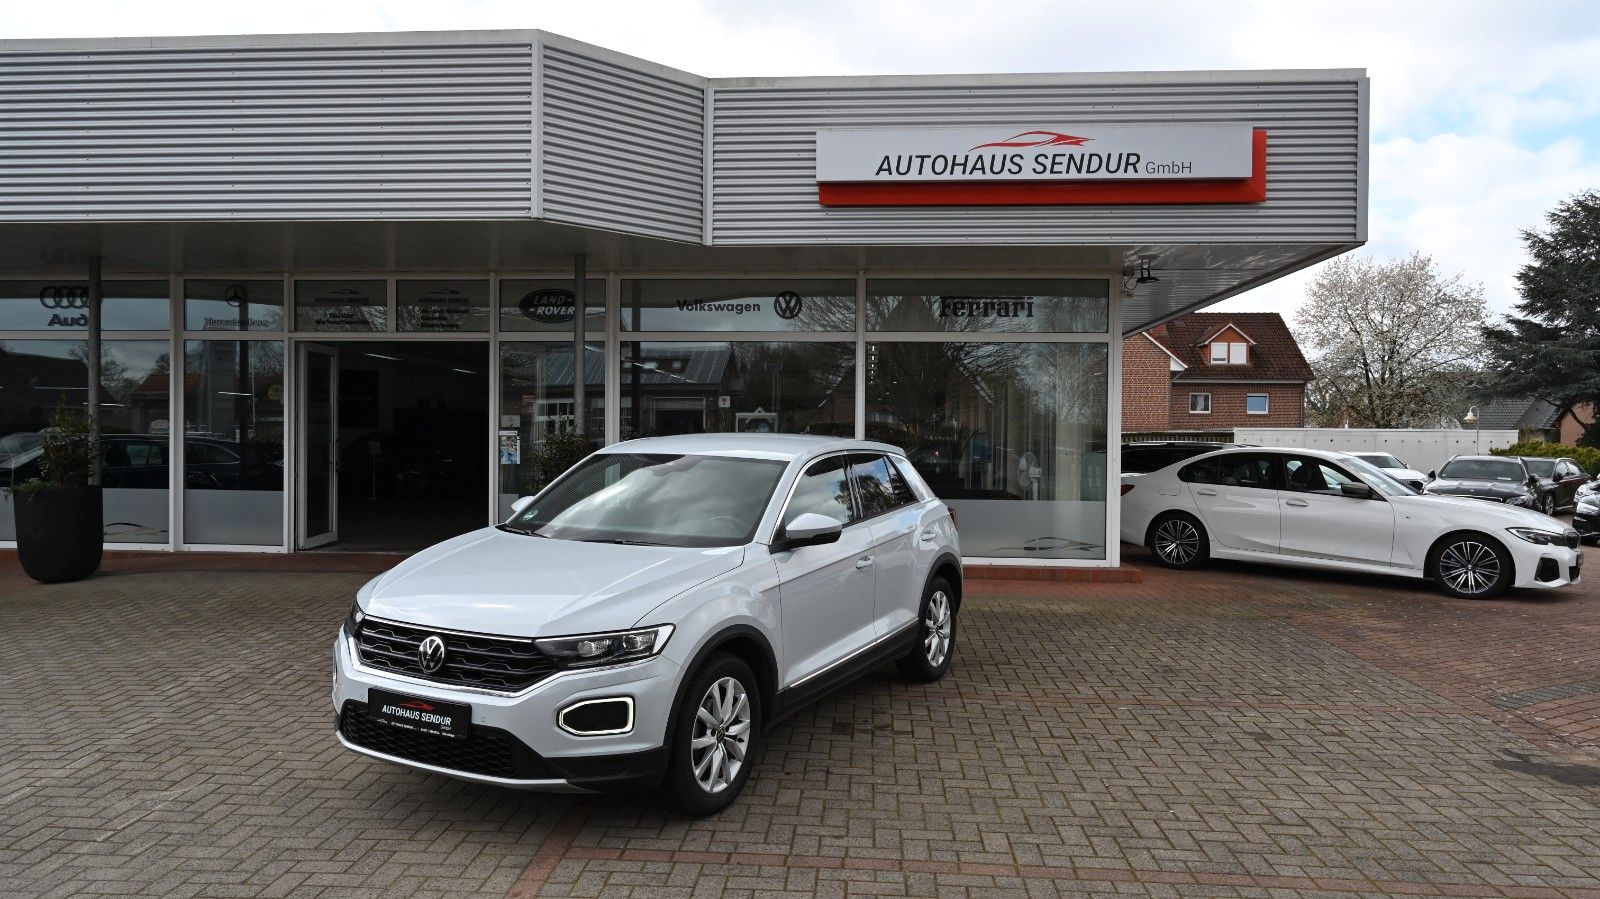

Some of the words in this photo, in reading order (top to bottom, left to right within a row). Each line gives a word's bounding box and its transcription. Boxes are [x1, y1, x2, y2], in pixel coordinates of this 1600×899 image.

[875, 152, 1024, 176] AUTOHAUS
[1032, 152, 1141, 175] SENDUR
[1145, 161, 1192, 174] GmbH
[676, 299, 761, 315] Volkswagen
[939, 296, 1034, 318] Ferrari
[47, 313, 90, 327] Aud
[204, 317, 270, 327] MercedeBenz
[381, 704, 420, 720] AUTOHAUS
[421, 712, 452, 726] SENDUR
